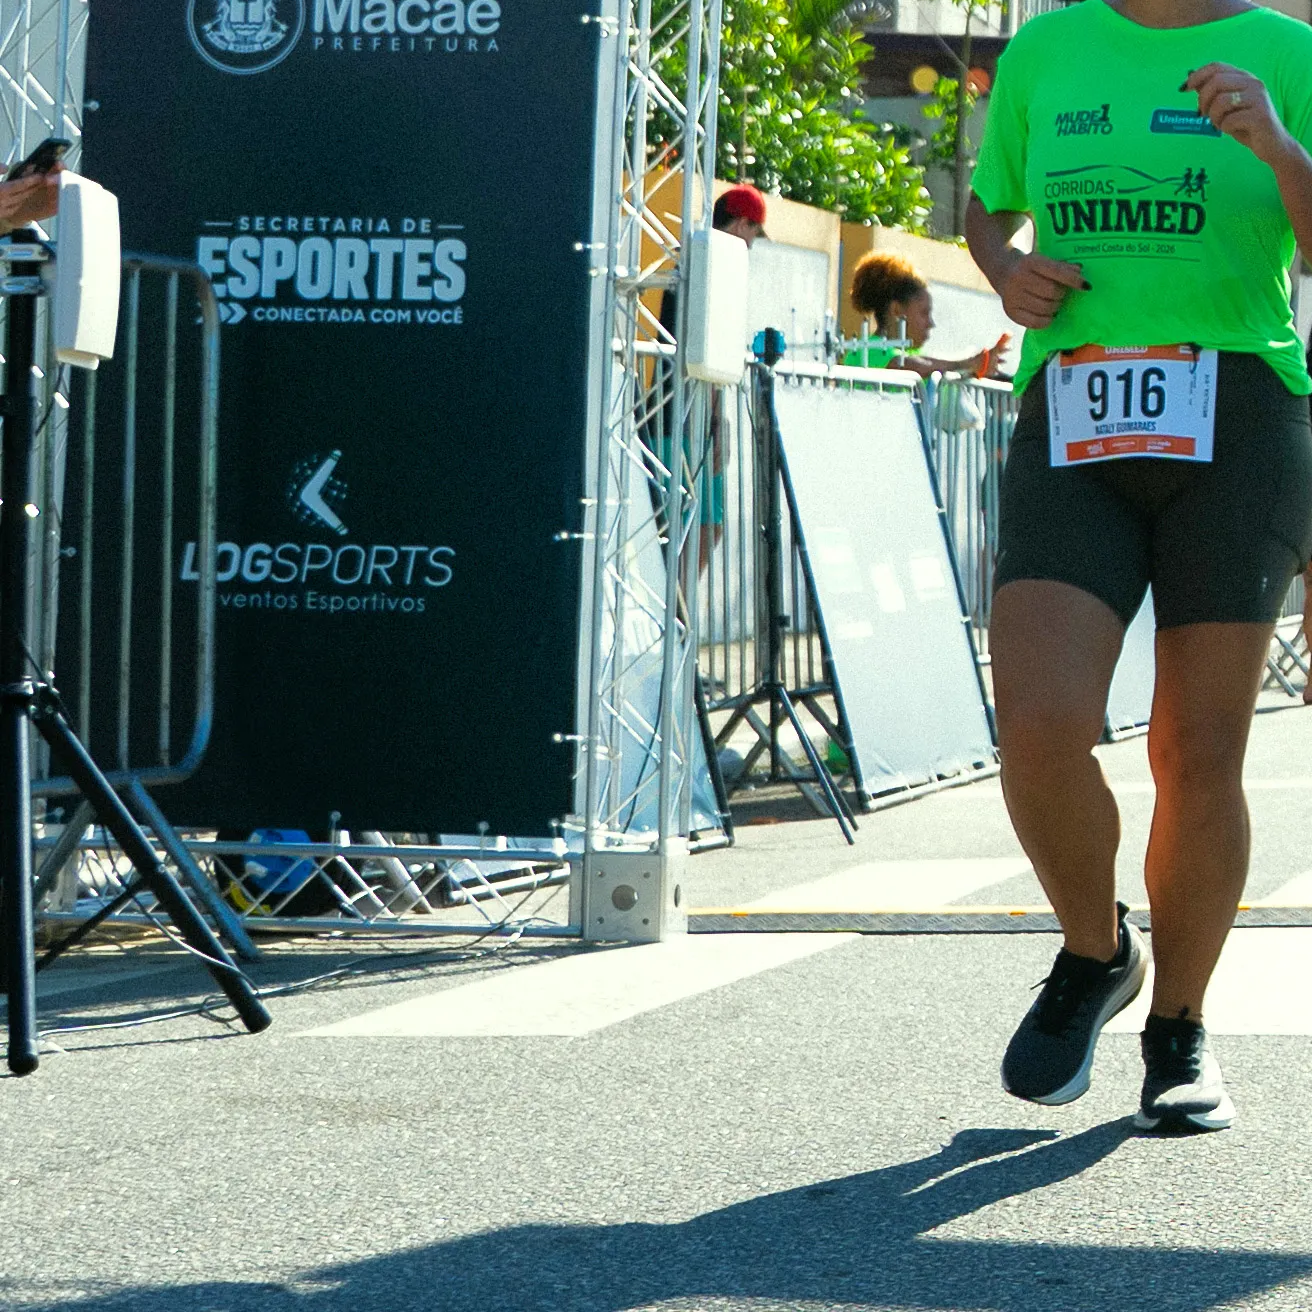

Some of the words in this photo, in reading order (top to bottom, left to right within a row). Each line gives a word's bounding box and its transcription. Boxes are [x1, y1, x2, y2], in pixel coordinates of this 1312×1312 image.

[314, 37, 500, 52] PREFEITURA
[1055, 110, 1101, 126] MUDE
[1159, 114, 1203, 126] Unimed
[1045, 180, 1115, 199] CORRIDAS
[239, 216, 391, 233] SECRETARIA
[403, 218, 433, 234] DE
[1046, 199, 1206, 236] UNIMED
[198, 236, 467, 301] ESPORTES
[254, 307, 365, 323] CONECTADA
[371, 308, 411, 324] COM
[416, 305, 464, 324] VOCÊ
[1087, 367, 1166, 421] 916
[219, 591, 298, 608] ventos
[306, 591, 425, 612] Esportivos
